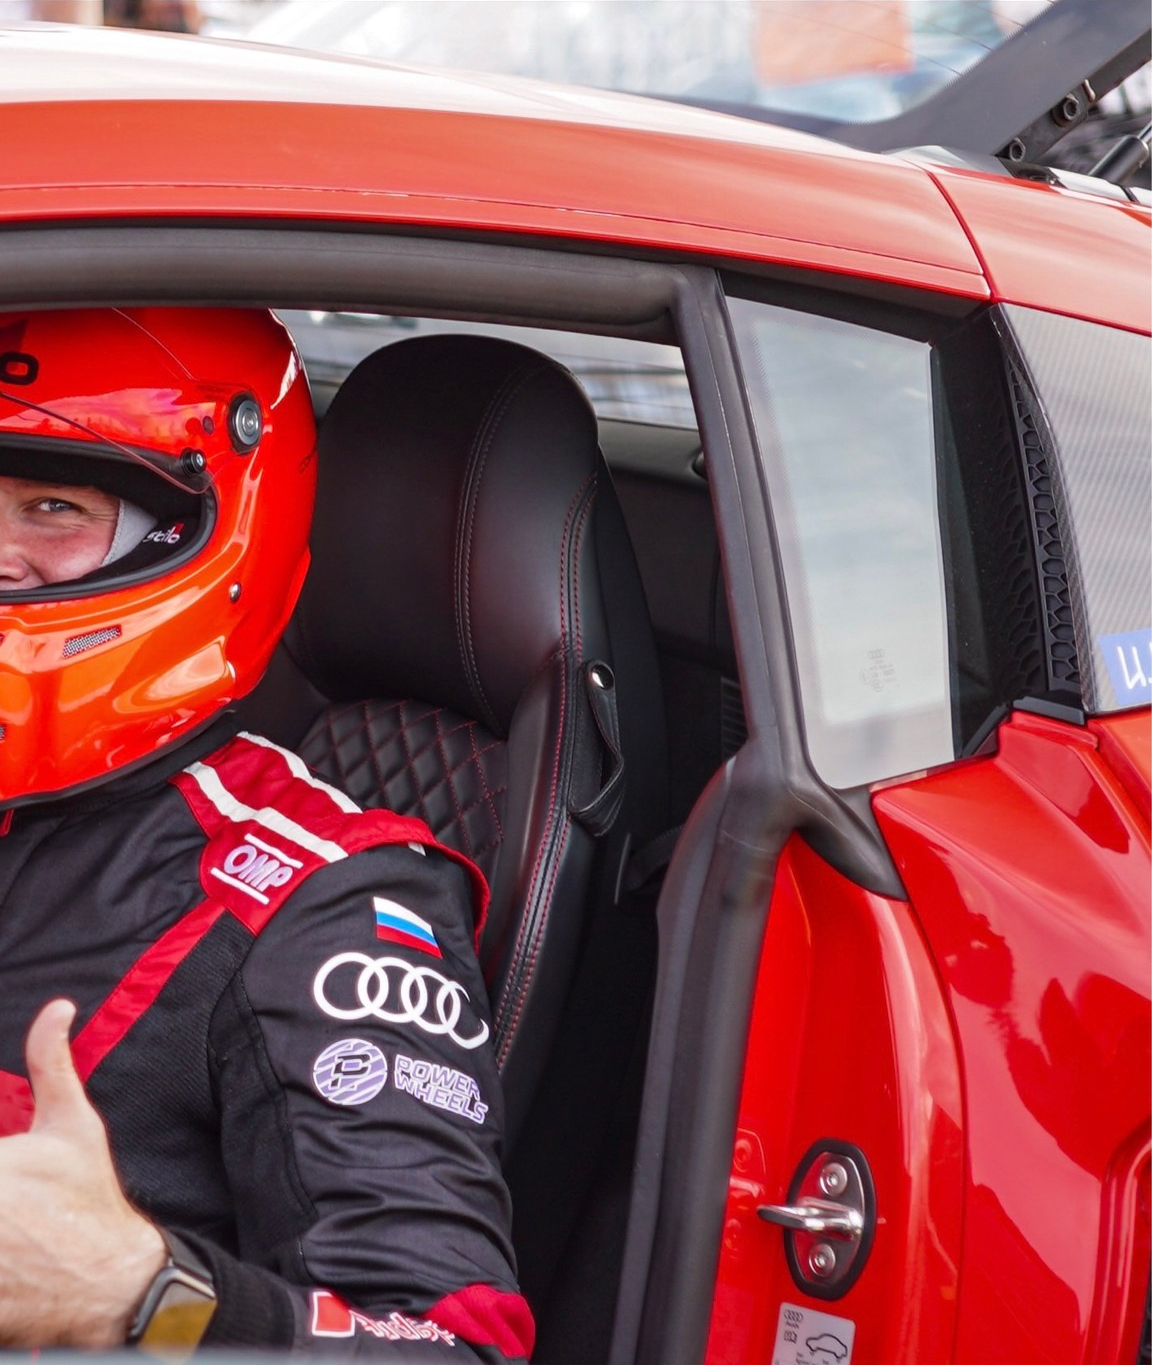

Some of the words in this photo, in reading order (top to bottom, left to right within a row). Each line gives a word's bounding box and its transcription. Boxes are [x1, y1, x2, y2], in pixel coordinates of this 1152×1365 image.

[224, 843, 293, 893] OMP
[394, 1054, 481, 1102] POWER
[394, 1070, 489, 1125] WHEELS
